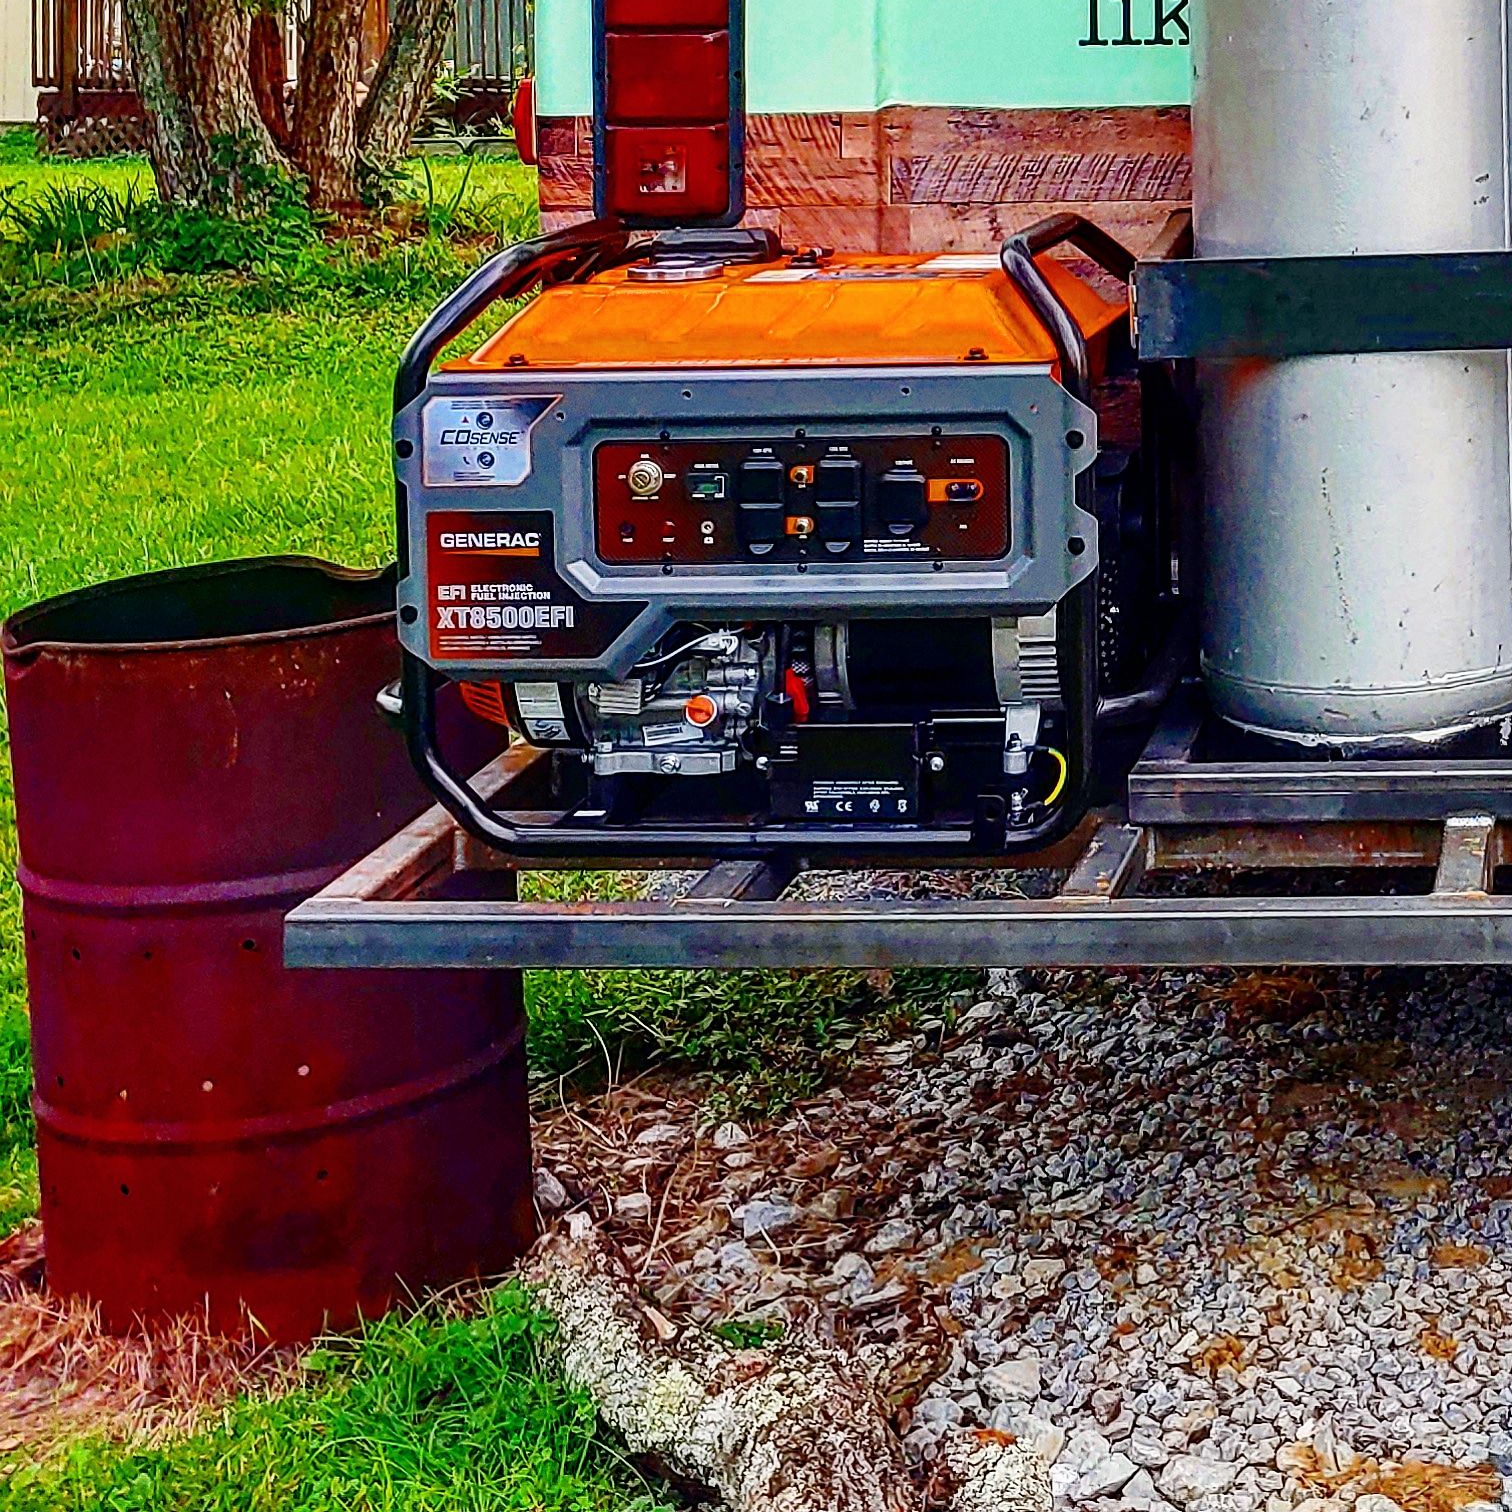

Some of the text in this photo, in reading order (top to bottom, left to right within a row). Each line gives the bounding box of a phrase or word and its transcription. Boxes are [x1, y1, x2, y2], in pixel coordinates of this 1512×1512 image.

[440, 532, 540, 548] GENERAC
[437, 585, 467, 600] EFI
[470, 583, 534, 593] ELECTRONIC
[470, 591, 551, 601] FUEL INJECTION
[436, 605, 575, 629] XT8500EFI
[835, 800, 854, 812] CE
